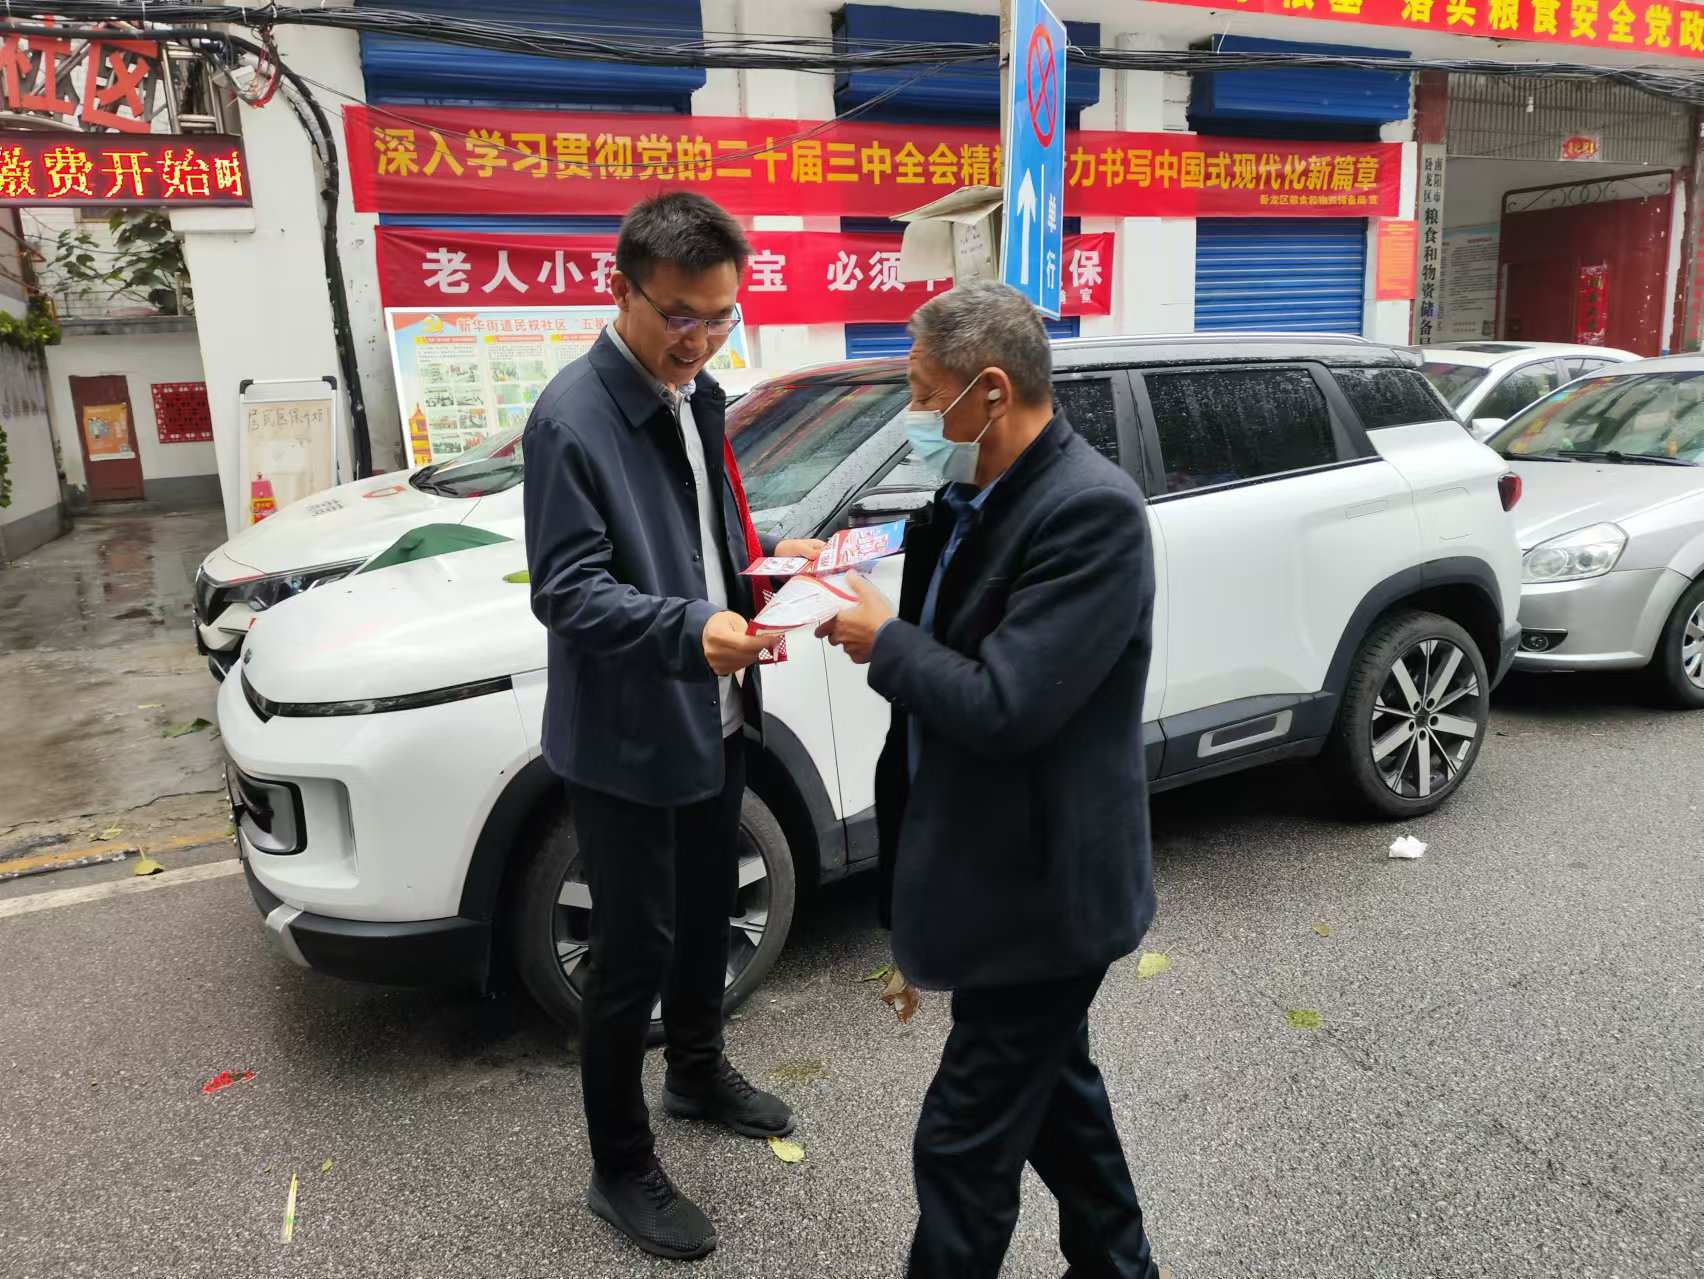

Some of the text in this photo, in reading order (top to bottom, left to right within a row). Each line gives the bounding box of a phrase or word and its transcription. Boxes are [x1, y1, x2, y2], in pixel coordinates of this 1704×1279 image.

[0, 14, 159, 133] 社区
[374, 127, 1379, 191] 深入学习贯彻党的二十届三中全会精 力书写中国式现代化新篇章
[1423, 157, 1433, 203] 卧龙区
